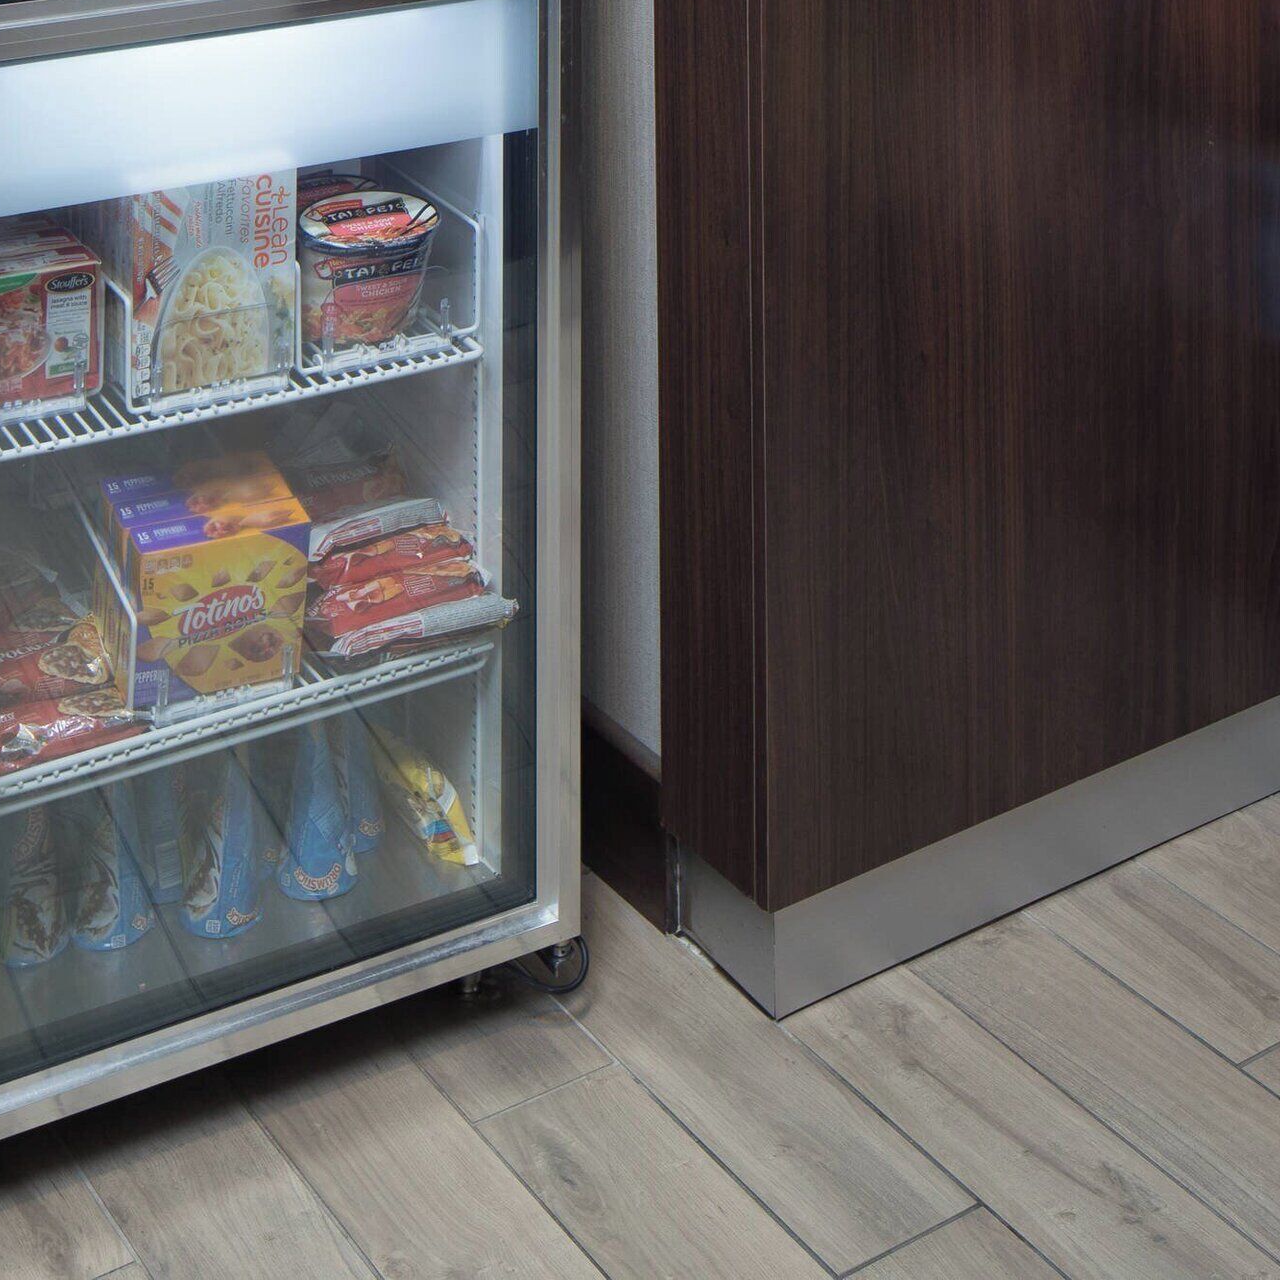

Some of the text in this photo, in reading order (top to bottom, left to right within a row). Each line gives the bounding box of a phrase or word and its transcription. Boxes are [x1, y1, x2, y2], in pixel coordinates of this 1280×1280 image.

[254, 175, 271, 269] cuisine
[349, 221, 392, 232] CHICKEN
[271, 206, 290, 265] Lean
[345, 258, 420, 279] TAI PEI
[50, 274, 92, 292] Stouffer's
[361, 286, 401, 298] CHICKEN
[137, 532, 150, 542] 15
[142, 578, 155, 591] 15
[173, 585, 266, 635] Totino's
